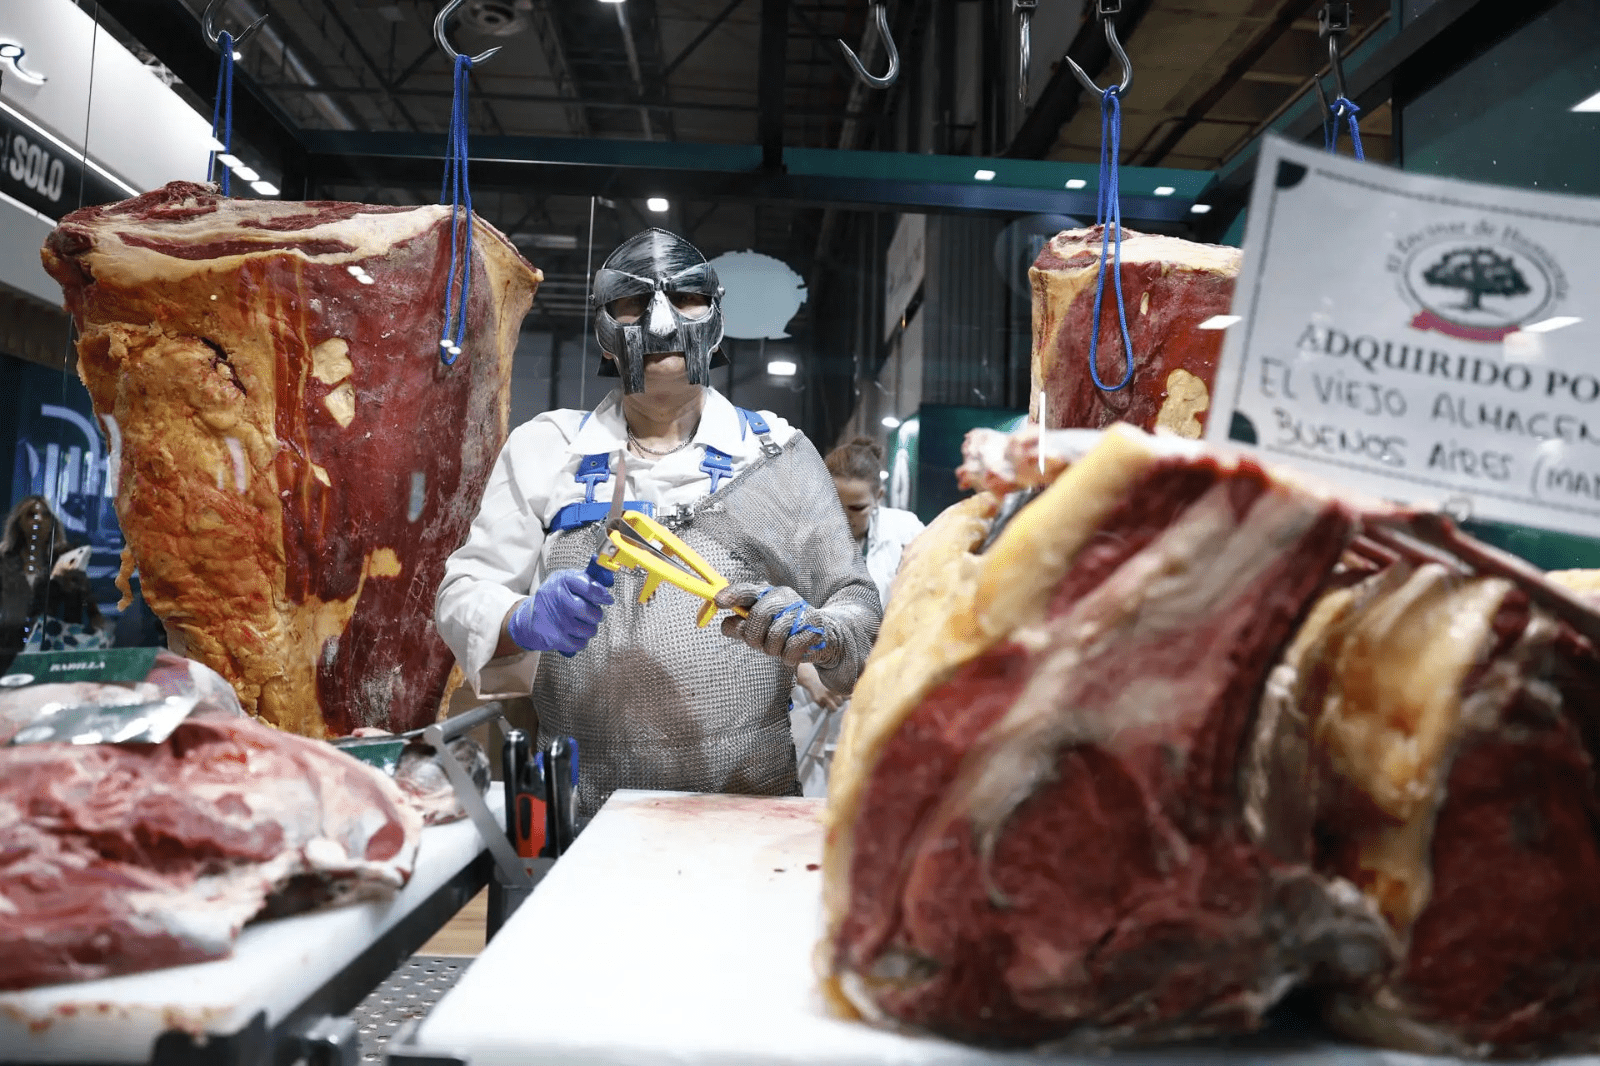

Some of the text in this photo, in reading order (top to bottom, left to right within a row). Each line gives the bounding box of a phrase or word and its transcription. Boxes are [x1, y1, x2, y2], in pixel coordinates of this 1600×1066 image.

[9, 134, 65, 202] SOLO
[1260, 356, 1299, 400] EL
[1295, 323, 1533, 392] ADQUIRIDO
[1273, 406, 1407, 468] BUENOS
